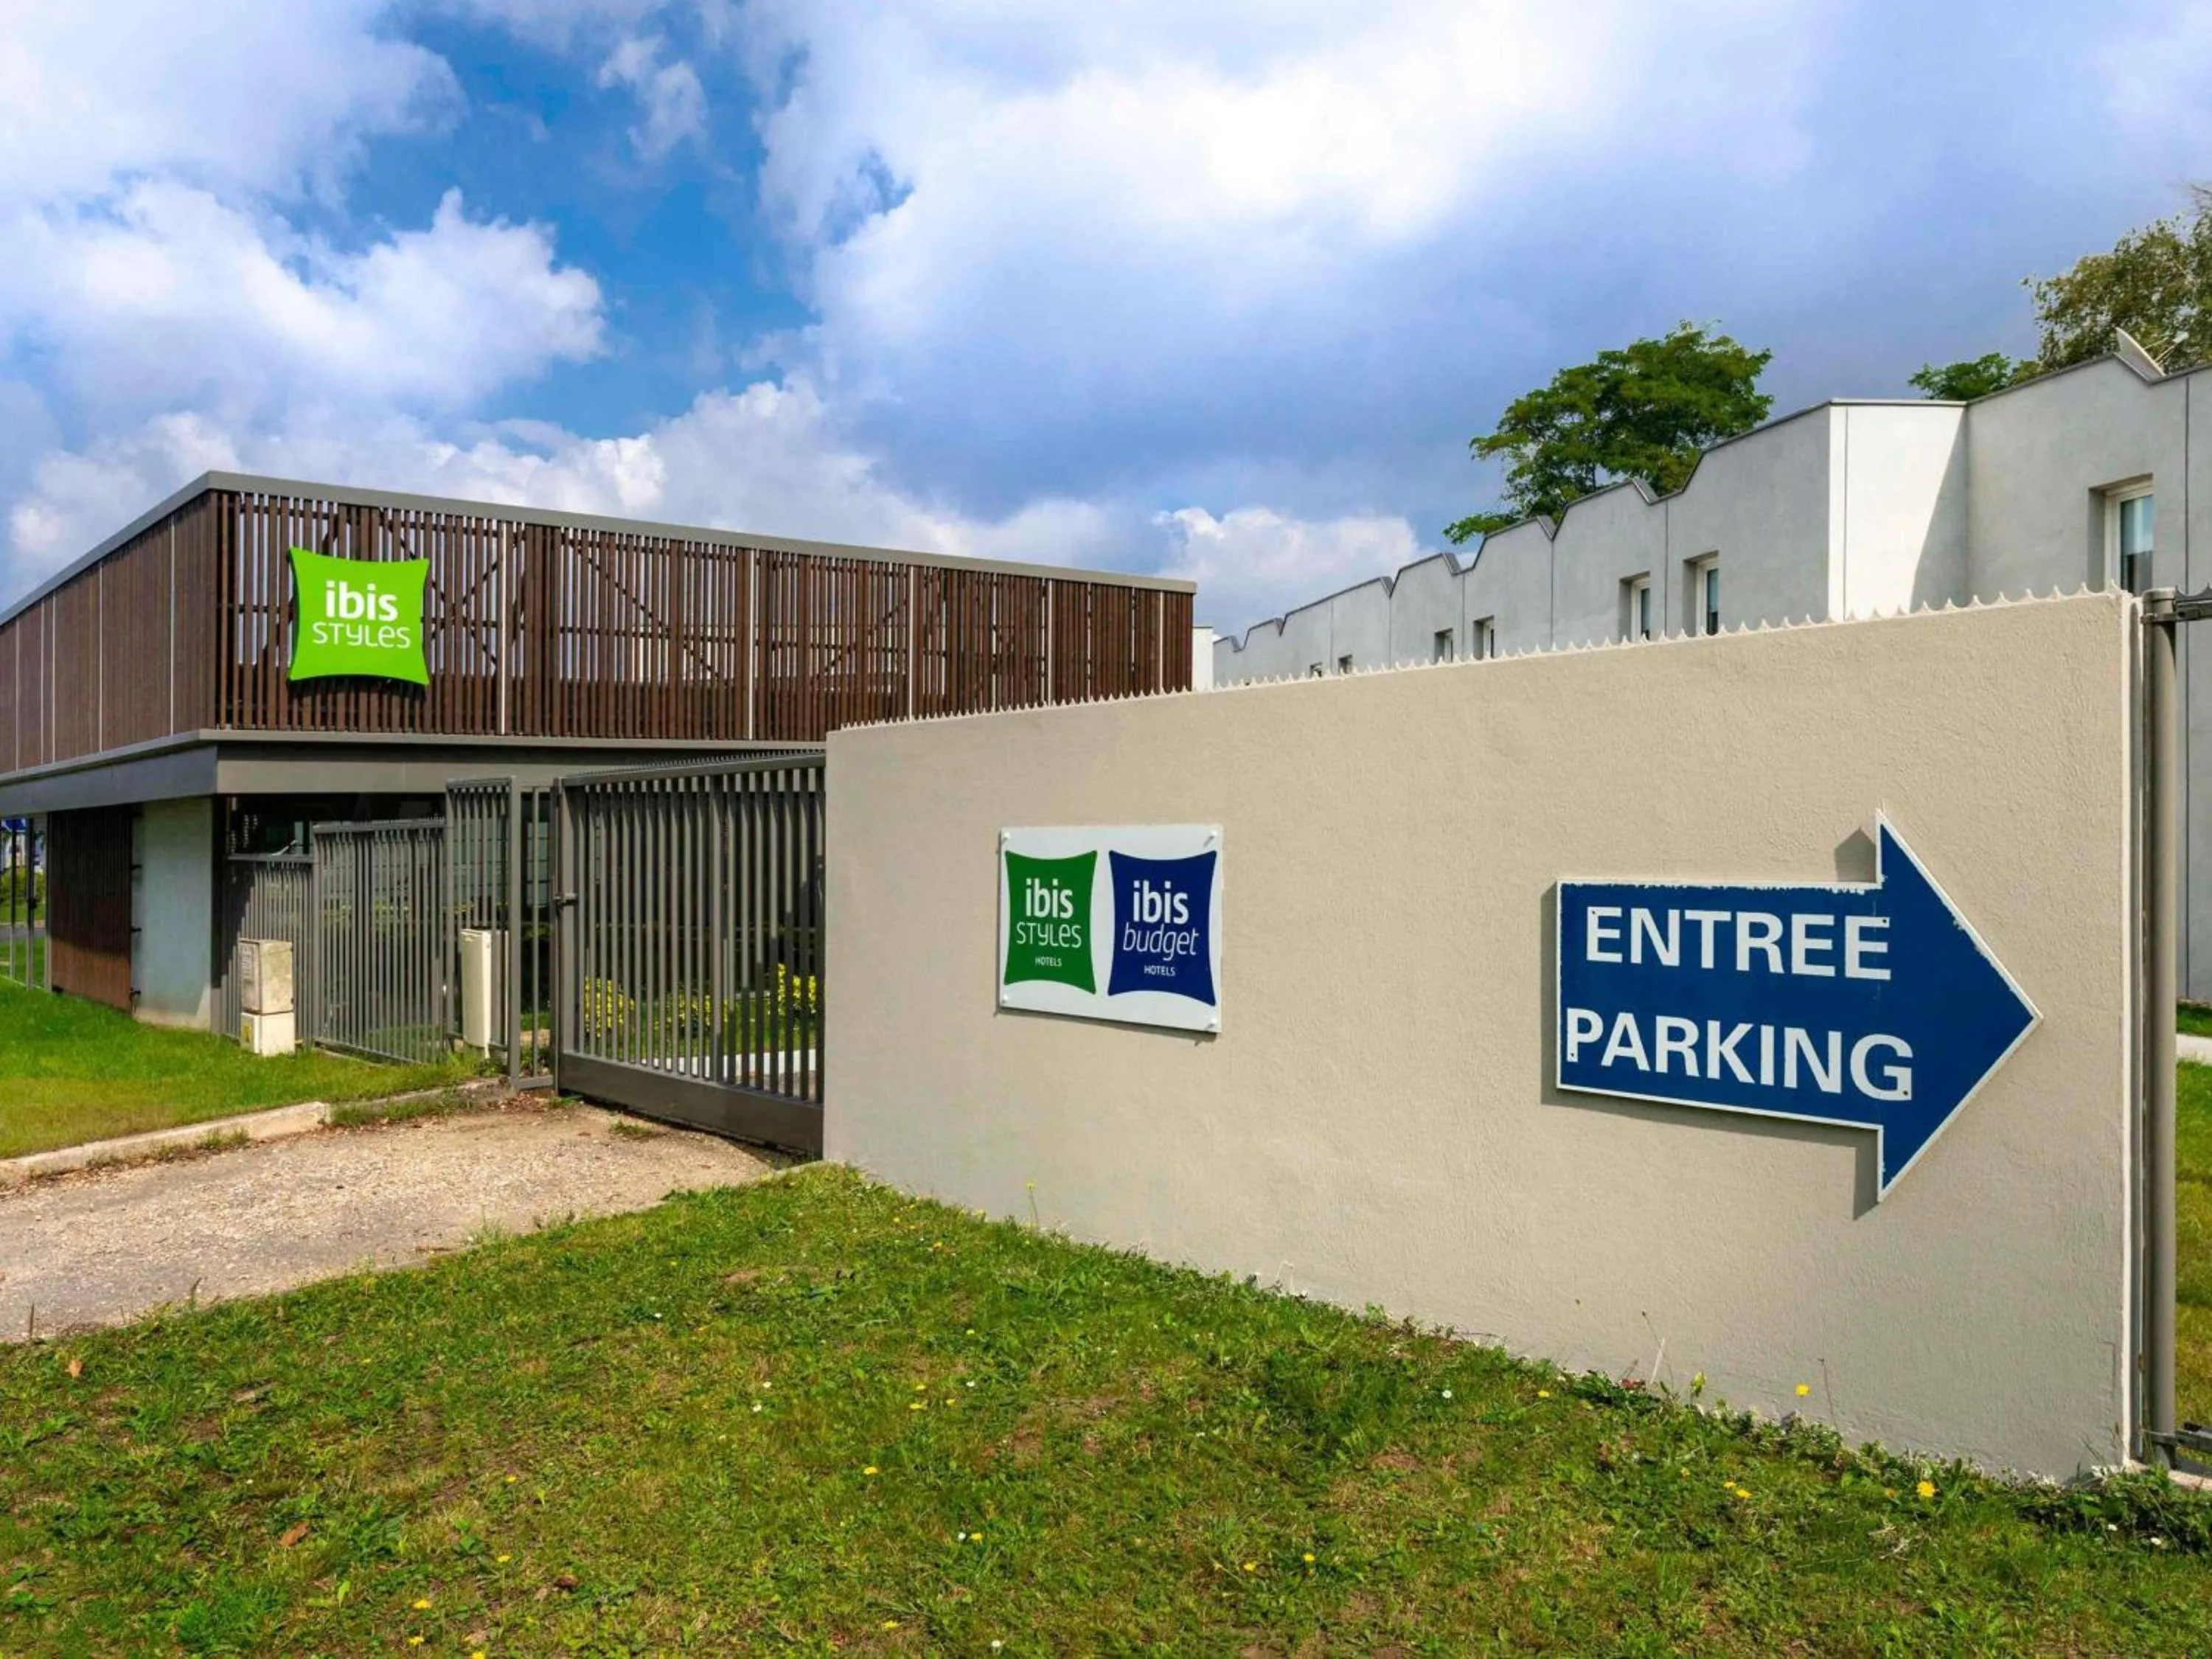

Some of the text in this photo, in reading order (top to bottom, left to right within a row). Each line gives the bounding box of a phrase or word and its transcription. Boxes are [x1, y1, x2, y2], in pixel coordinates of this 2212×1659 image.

[324, 580, 398, 622] ibis
[1026, 878, 1074, 919] ibis
[1133, 880, 1189, 924] ibis
[1034, 956, 1062, 967] HOTELS
[1122, 922, 1199, 961] budget
[1587, 905, 1891, 980] ENTREE
[1144, 964, 1175, 977] HOTELS
[1565, 1007, 1913, 1102] PARKING
